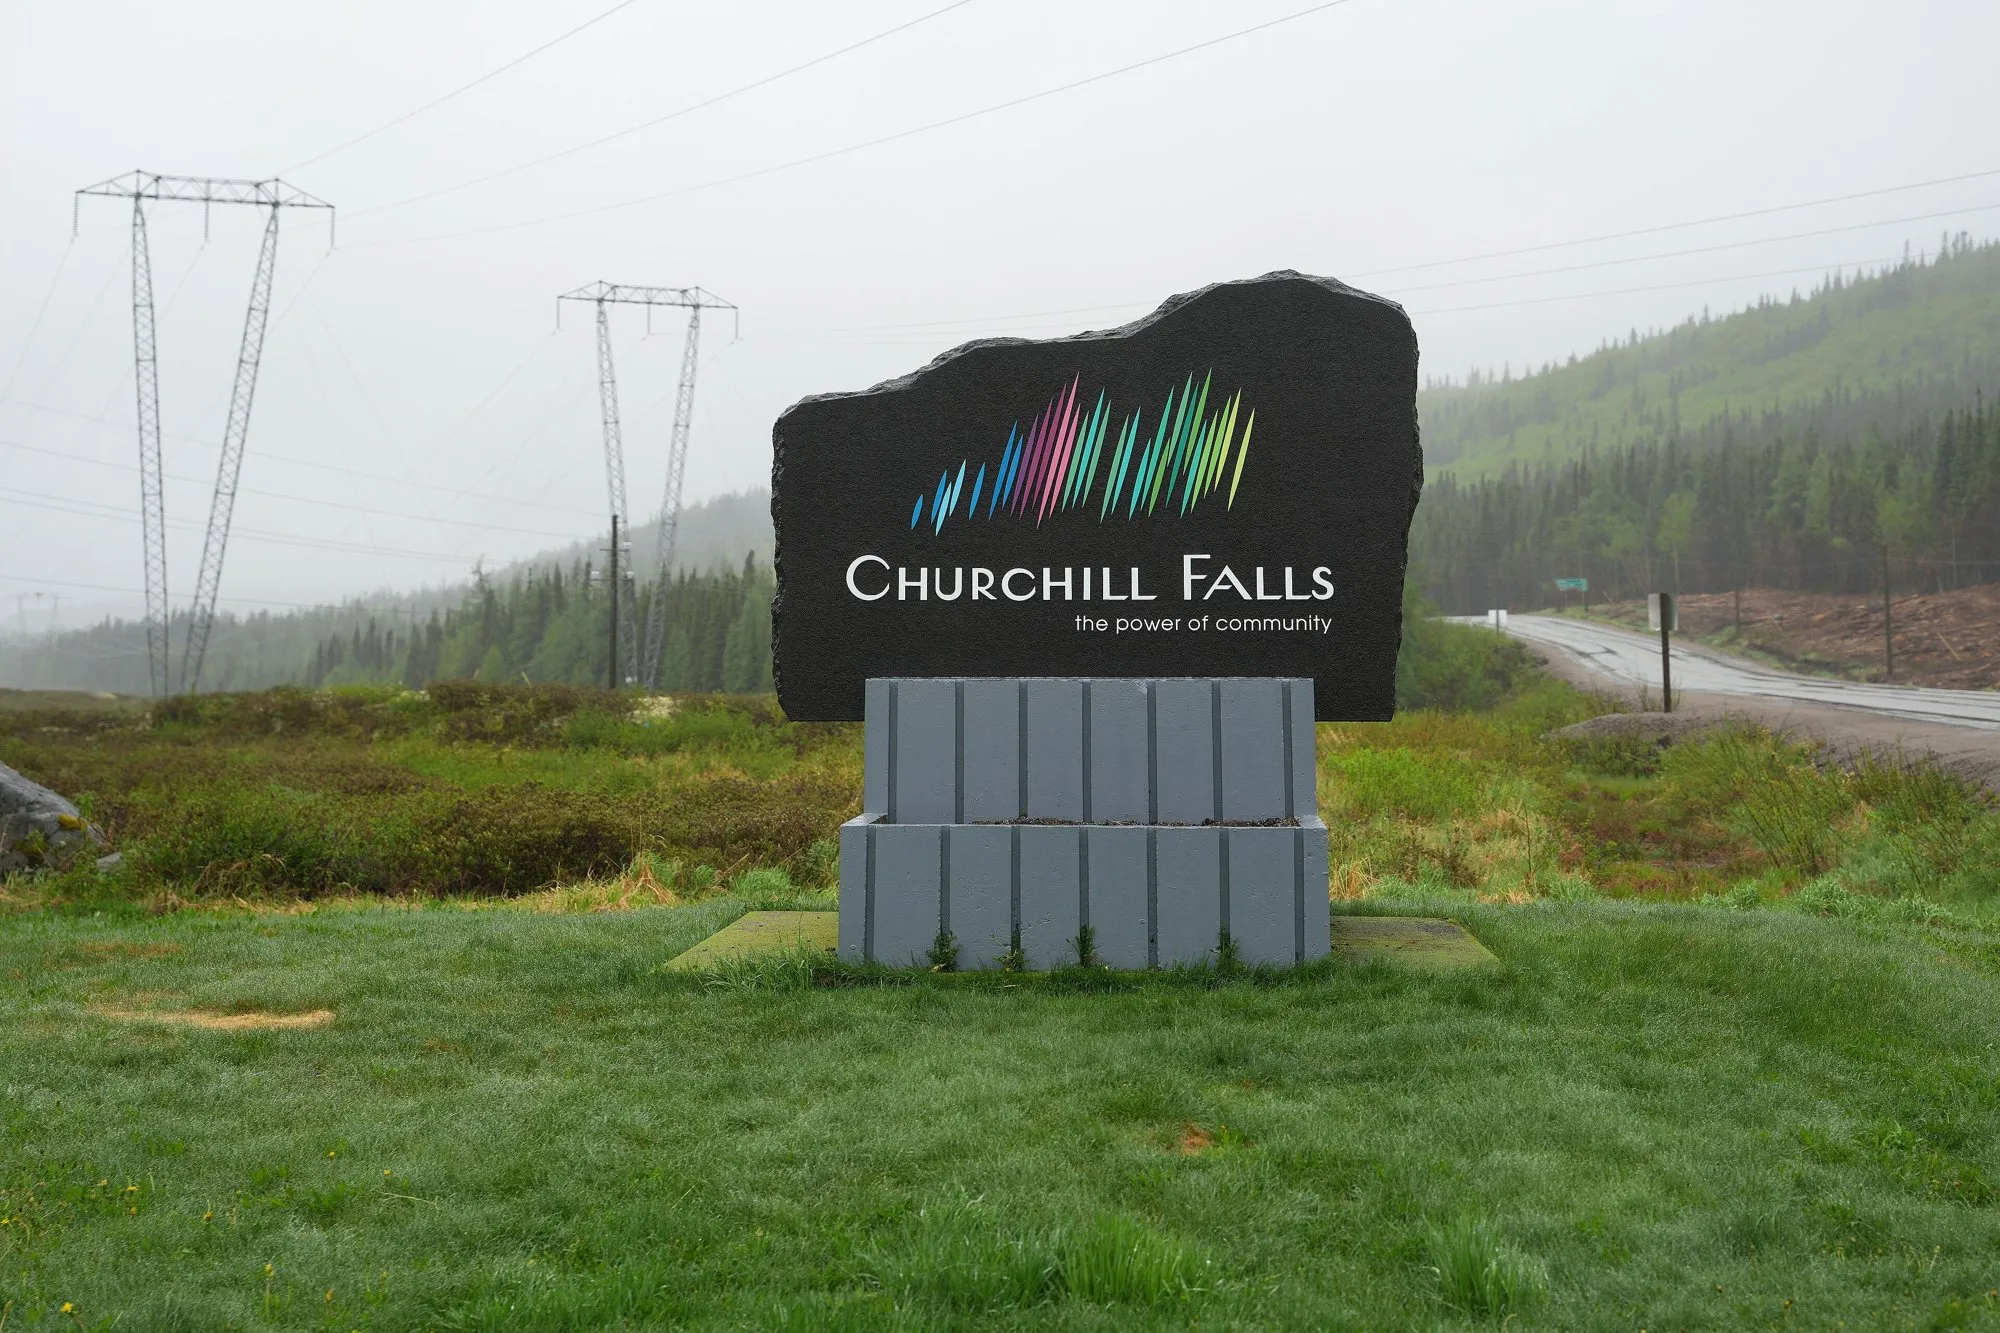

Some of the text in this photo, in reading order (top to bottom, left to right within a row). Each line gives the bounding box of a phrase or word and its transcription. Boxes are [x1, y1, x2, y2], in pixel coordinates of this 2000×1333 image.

[845, 553, 1335, 602] CHURCHILL FALLS
[1074, 614, 1333, 635] the power of community
